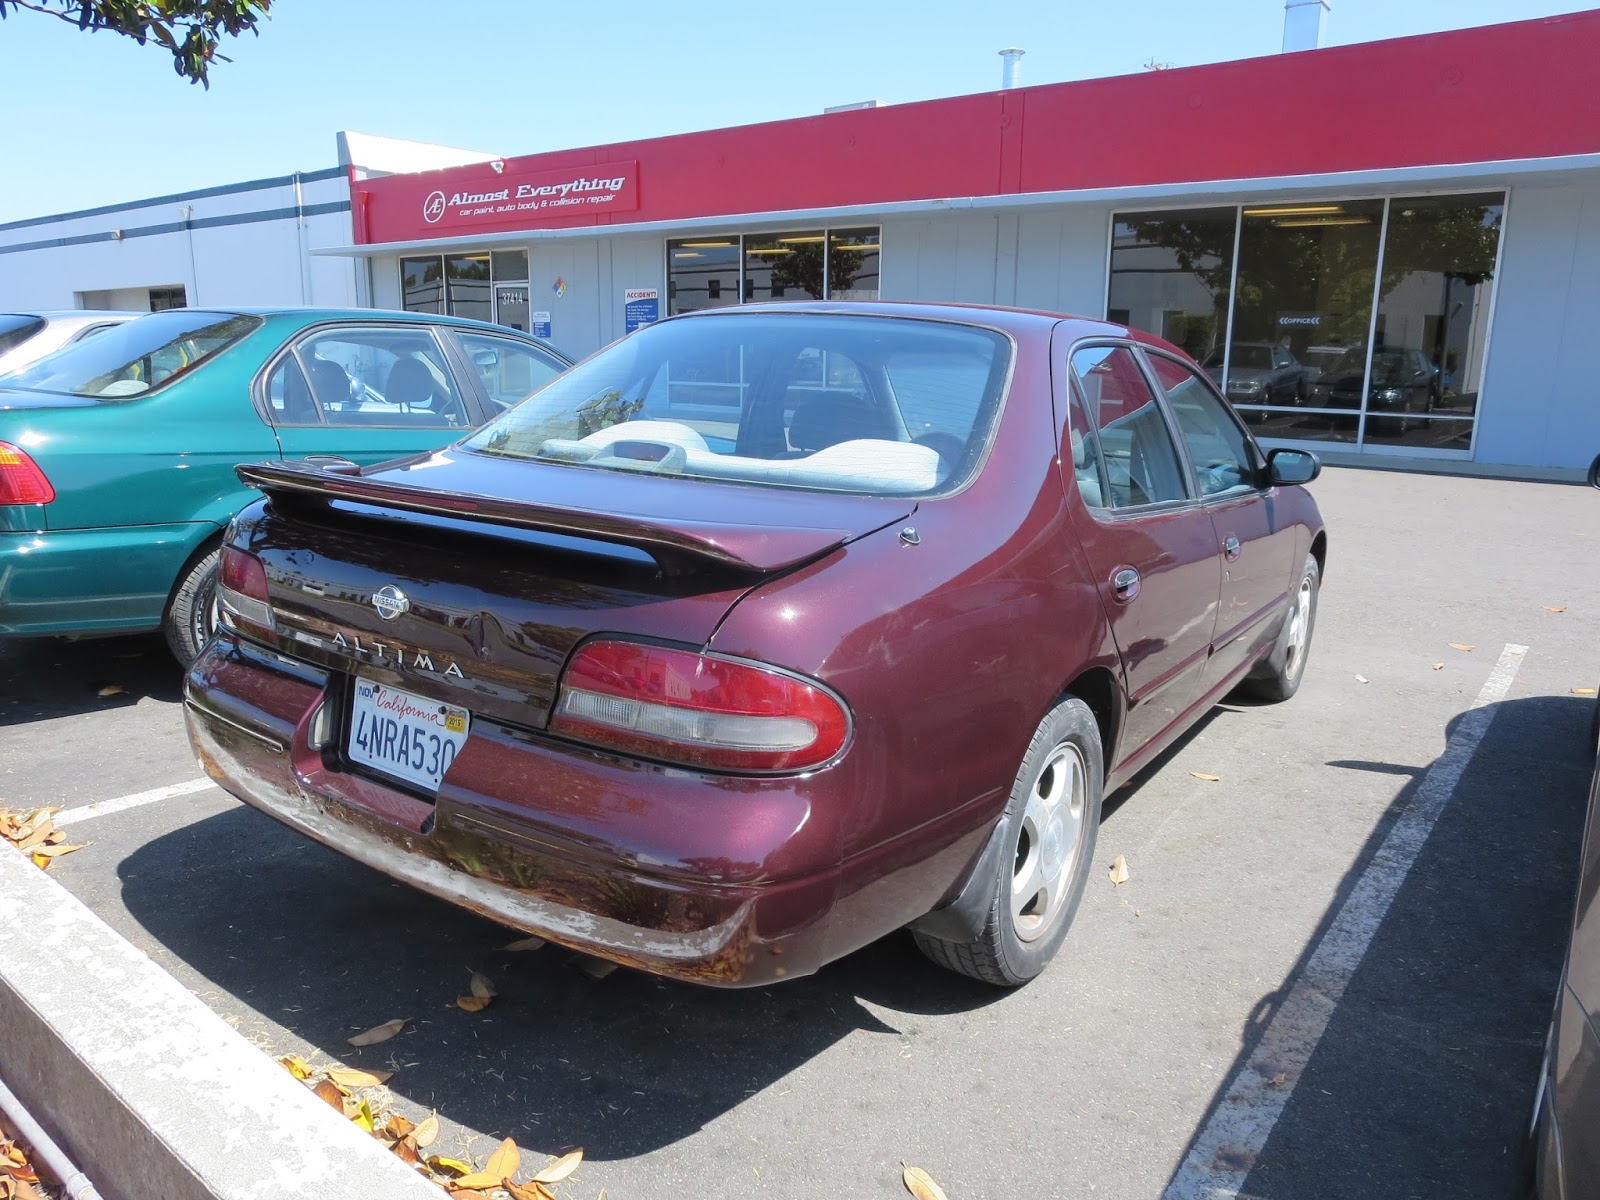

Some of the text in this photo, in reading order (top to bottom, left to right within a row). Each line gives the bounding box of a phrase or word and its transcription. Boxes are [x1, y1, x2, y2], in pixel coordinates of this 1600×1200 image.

[448, 177, 626, 206] Almost Everything
[459, 208, 473, 216] car
[496, 203, 516, 212] auto
[517, 200, 540, 211] body
[541, 200, 548, 208] &
[549, 195, 586, 206] collision
[586, 192, 616, 204] repair
[502, 293, 523, 305] 37414
[374, 595, 399, 608] NISSAN
[332, 632, 464, 678] ALTIMA
[358, 685, 447, 726] NOV California
[449, 717, 461, 726] 2015
[356, 711, 456, 777] 4NRA530
